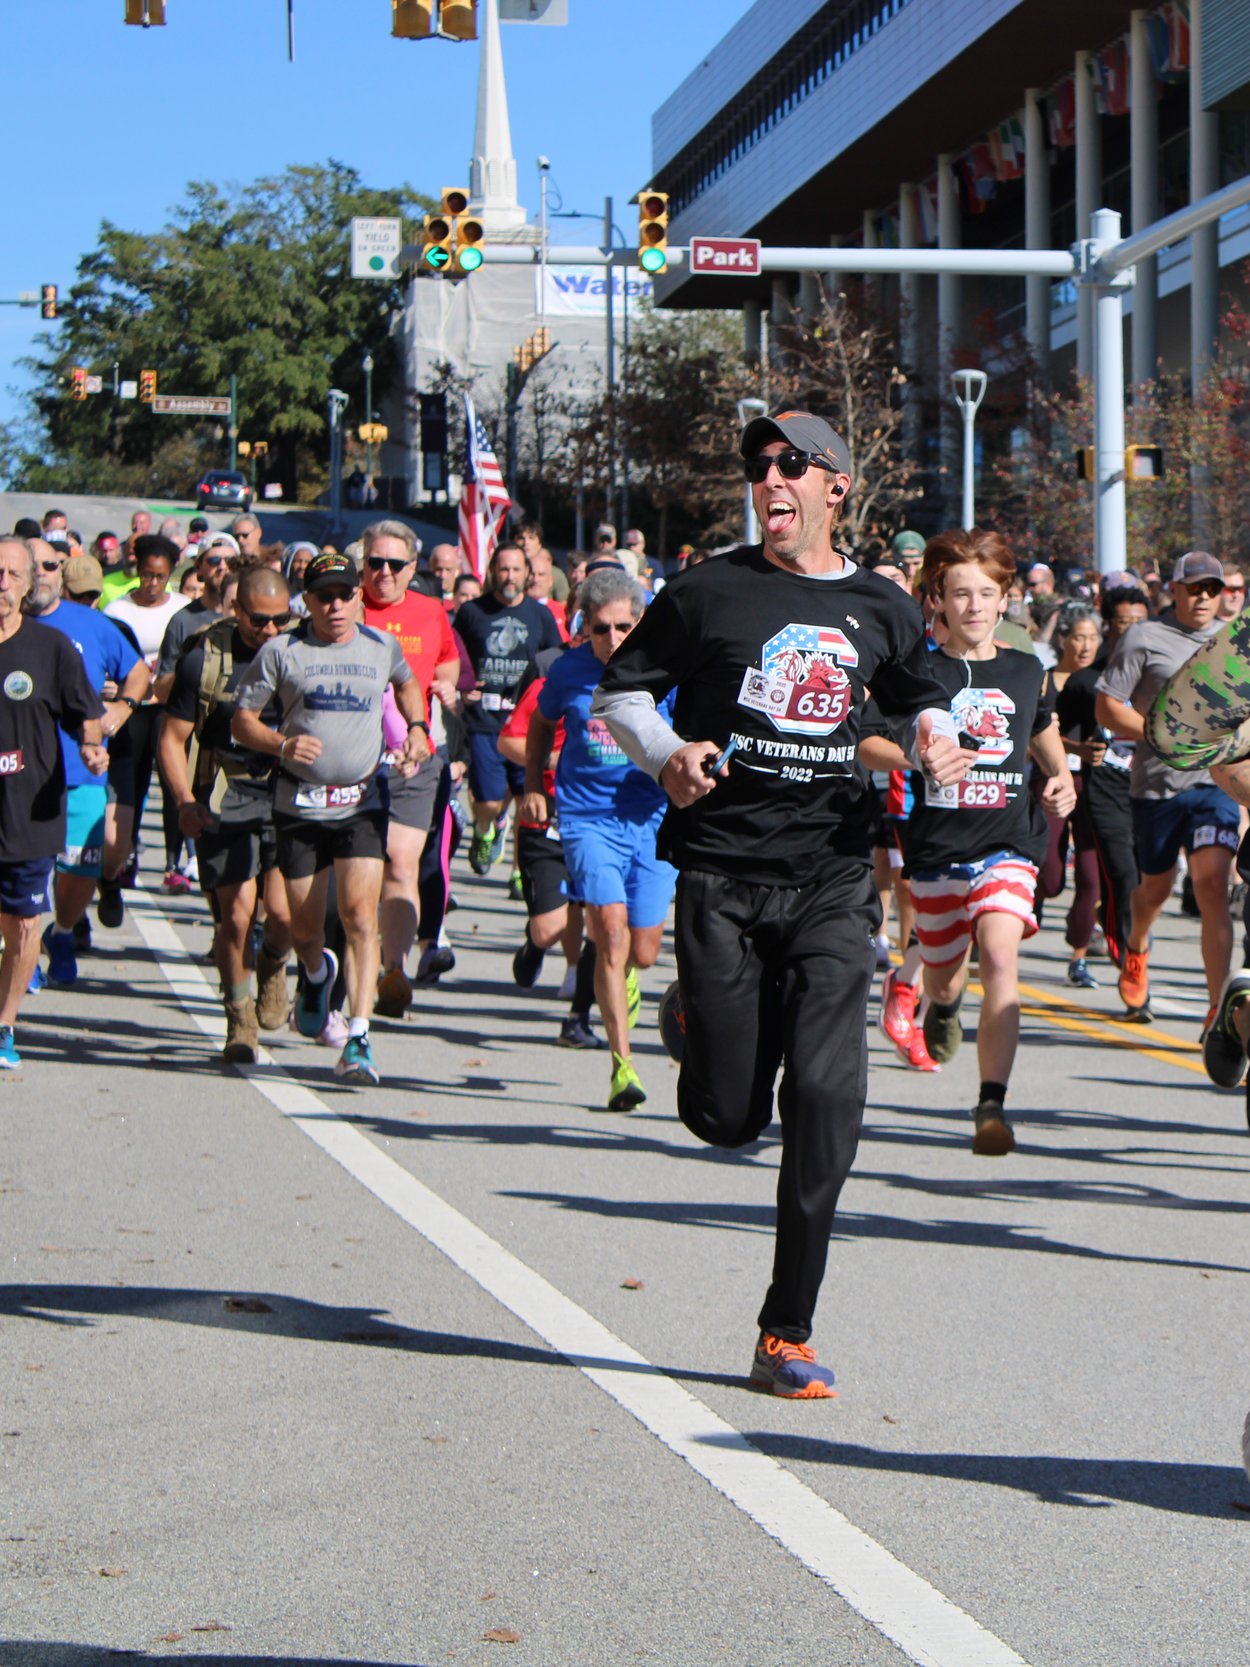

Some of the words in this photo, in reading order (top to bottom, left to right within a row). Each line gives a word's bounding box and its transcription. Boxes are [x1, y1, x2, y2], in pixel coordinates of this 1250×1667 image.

[365, 232, 389, 242] YIELD
[697, 246, 753, 266] Park
[169, 399, 215, 411] Assembly
[304, 664, 333, 679] COLUMBIA
[334, 663, 362, 677] RUNNING
[362, 664, 377, 680] CLUB
[797, 691, 845, 718] 635
[756, 739, 825, 762] VETERANS
[827, 746, 846, 762] DAY
[780, 765, 813, 782] 2022
[966, 769, 998, 783] ERANS
[330, 785, 361, 804] 455
[964, 784, 1000, 805] 629
